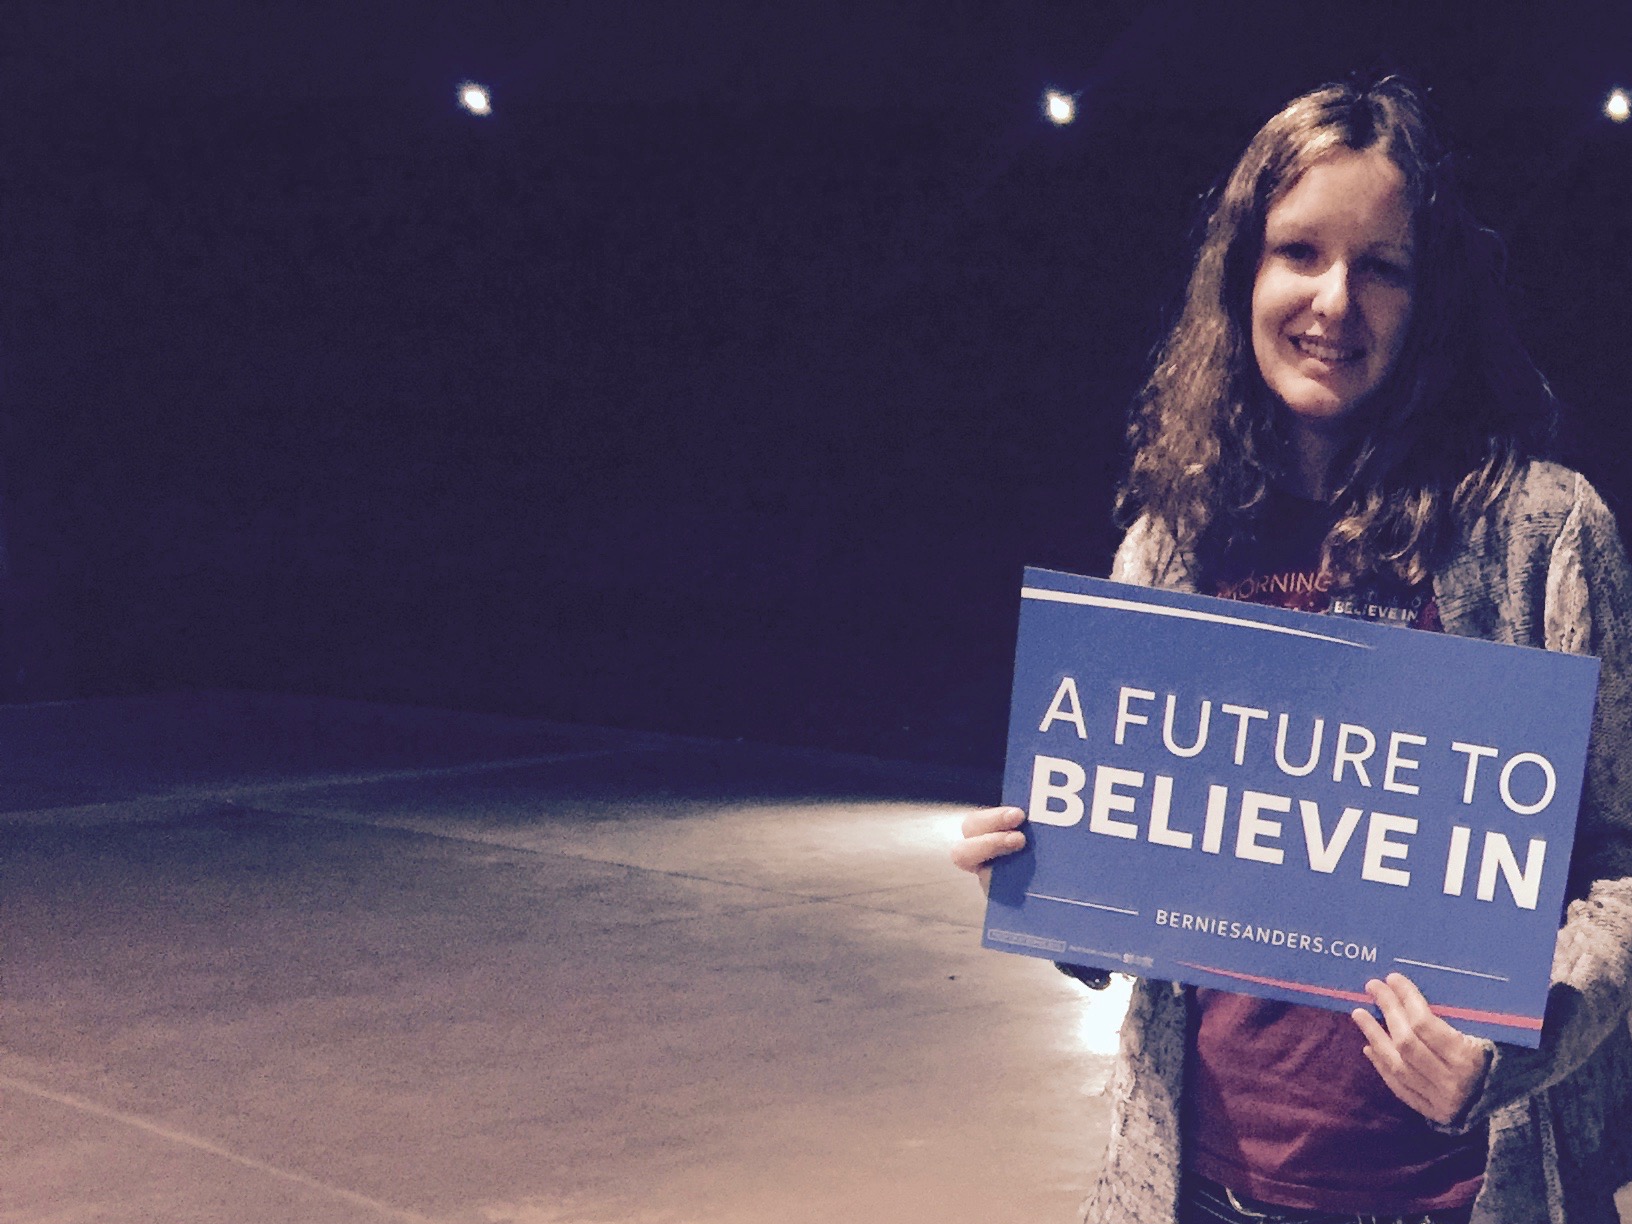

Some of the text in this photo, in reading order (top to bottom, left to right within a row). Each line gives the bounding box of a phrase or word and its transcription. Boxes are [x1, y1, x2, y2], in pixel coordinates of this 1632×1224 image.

[1039, 676, 1557, 815] A FUTURE TO
[1028, 754, 1548, 911] BELIEVE IN
[1155, 908, 1378, 963] BERNIESANDERS.COM
